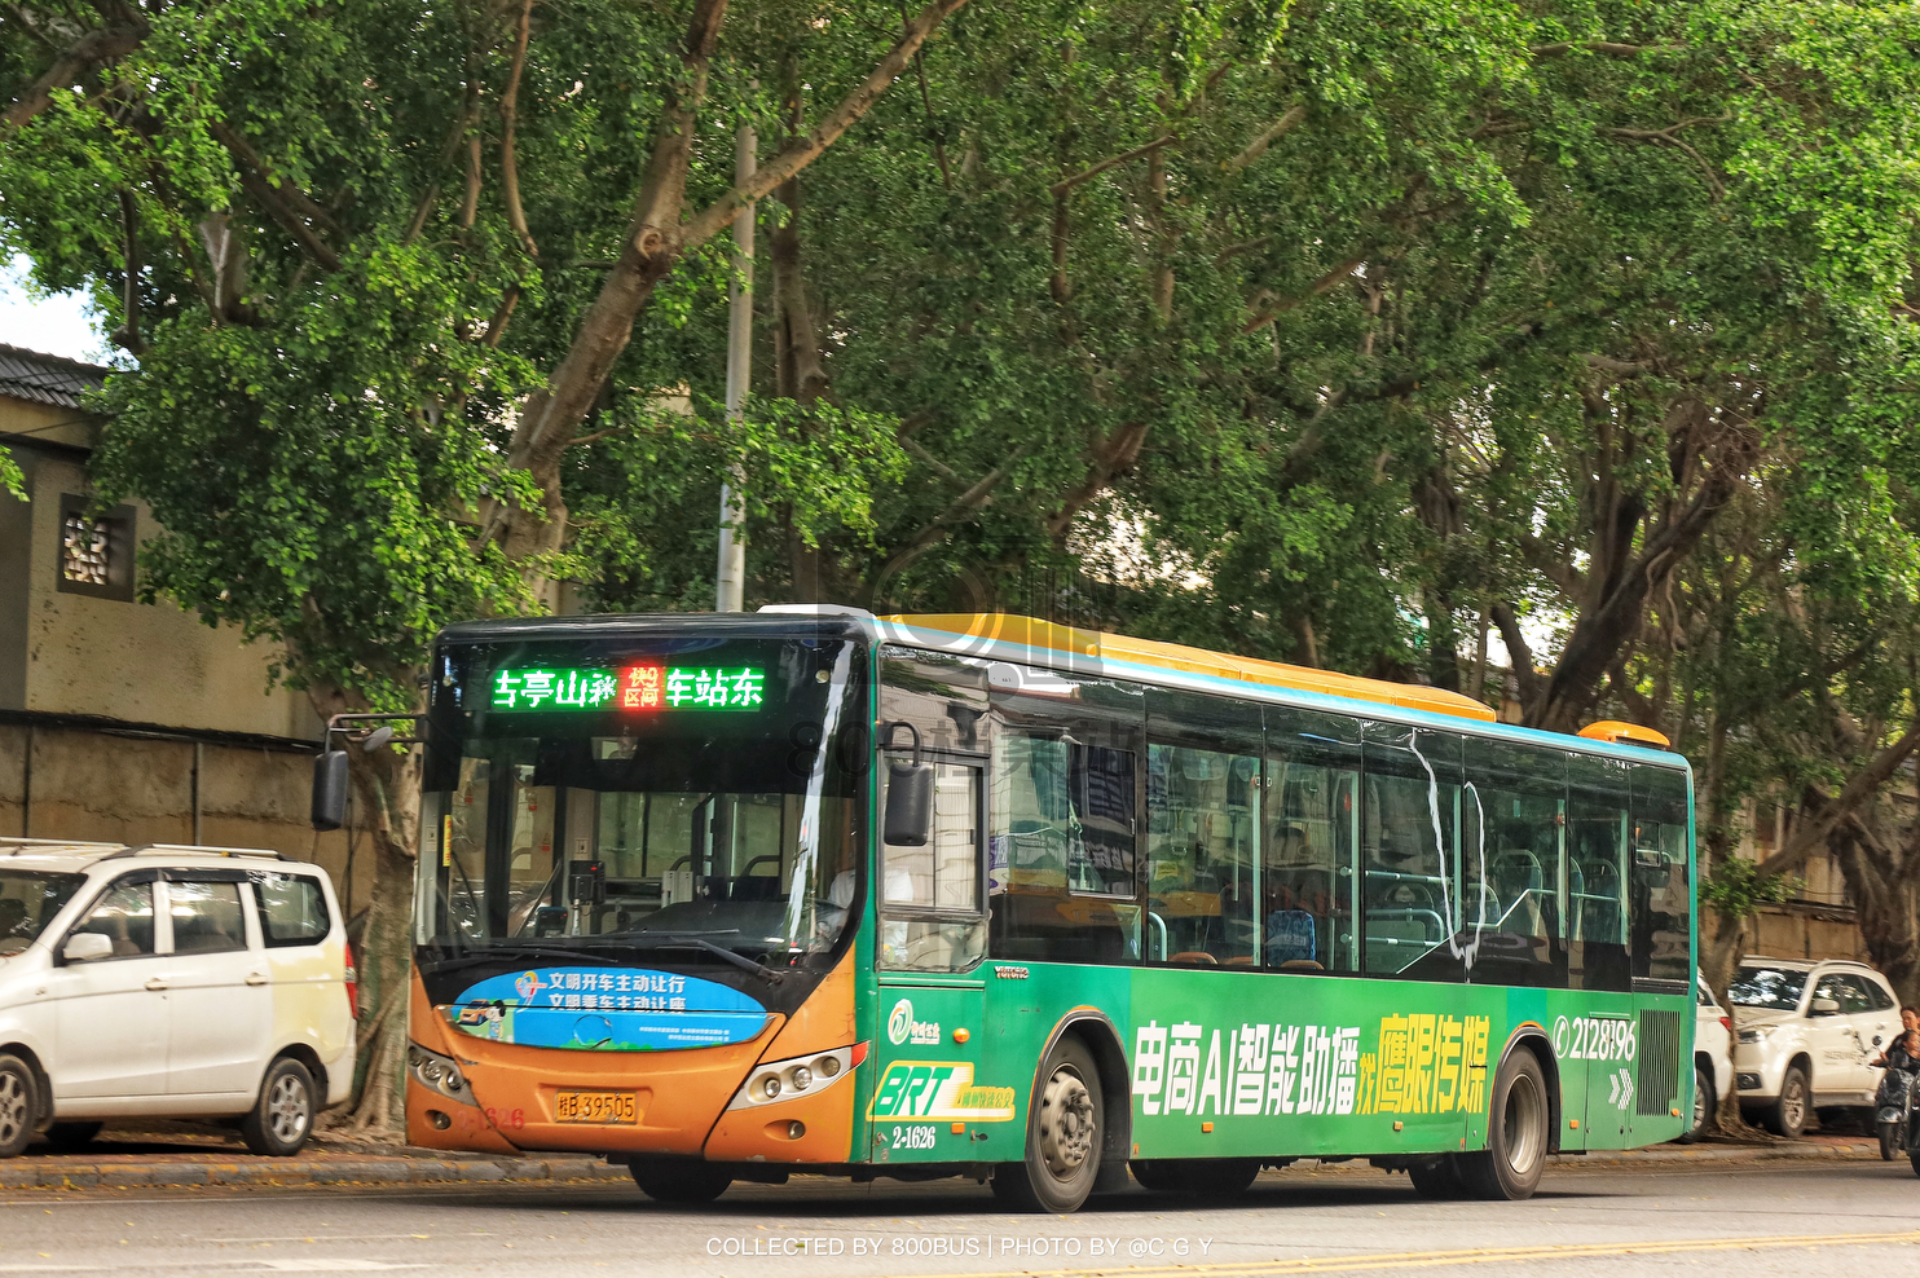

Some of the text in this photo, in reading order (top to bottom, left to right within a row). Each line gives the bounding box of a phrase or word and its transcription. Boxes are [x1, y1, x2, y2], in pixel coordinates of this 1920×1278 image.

[665, 667, 765, 707] 车站东
[548, 972, 686, 994] 文明开车主动让行
[548, 993, 687, 1014] 文明乘车主动让座
[1569, 1016, 1636, 1061] 2128196
[869, 1066, 954, 1116] BRT
